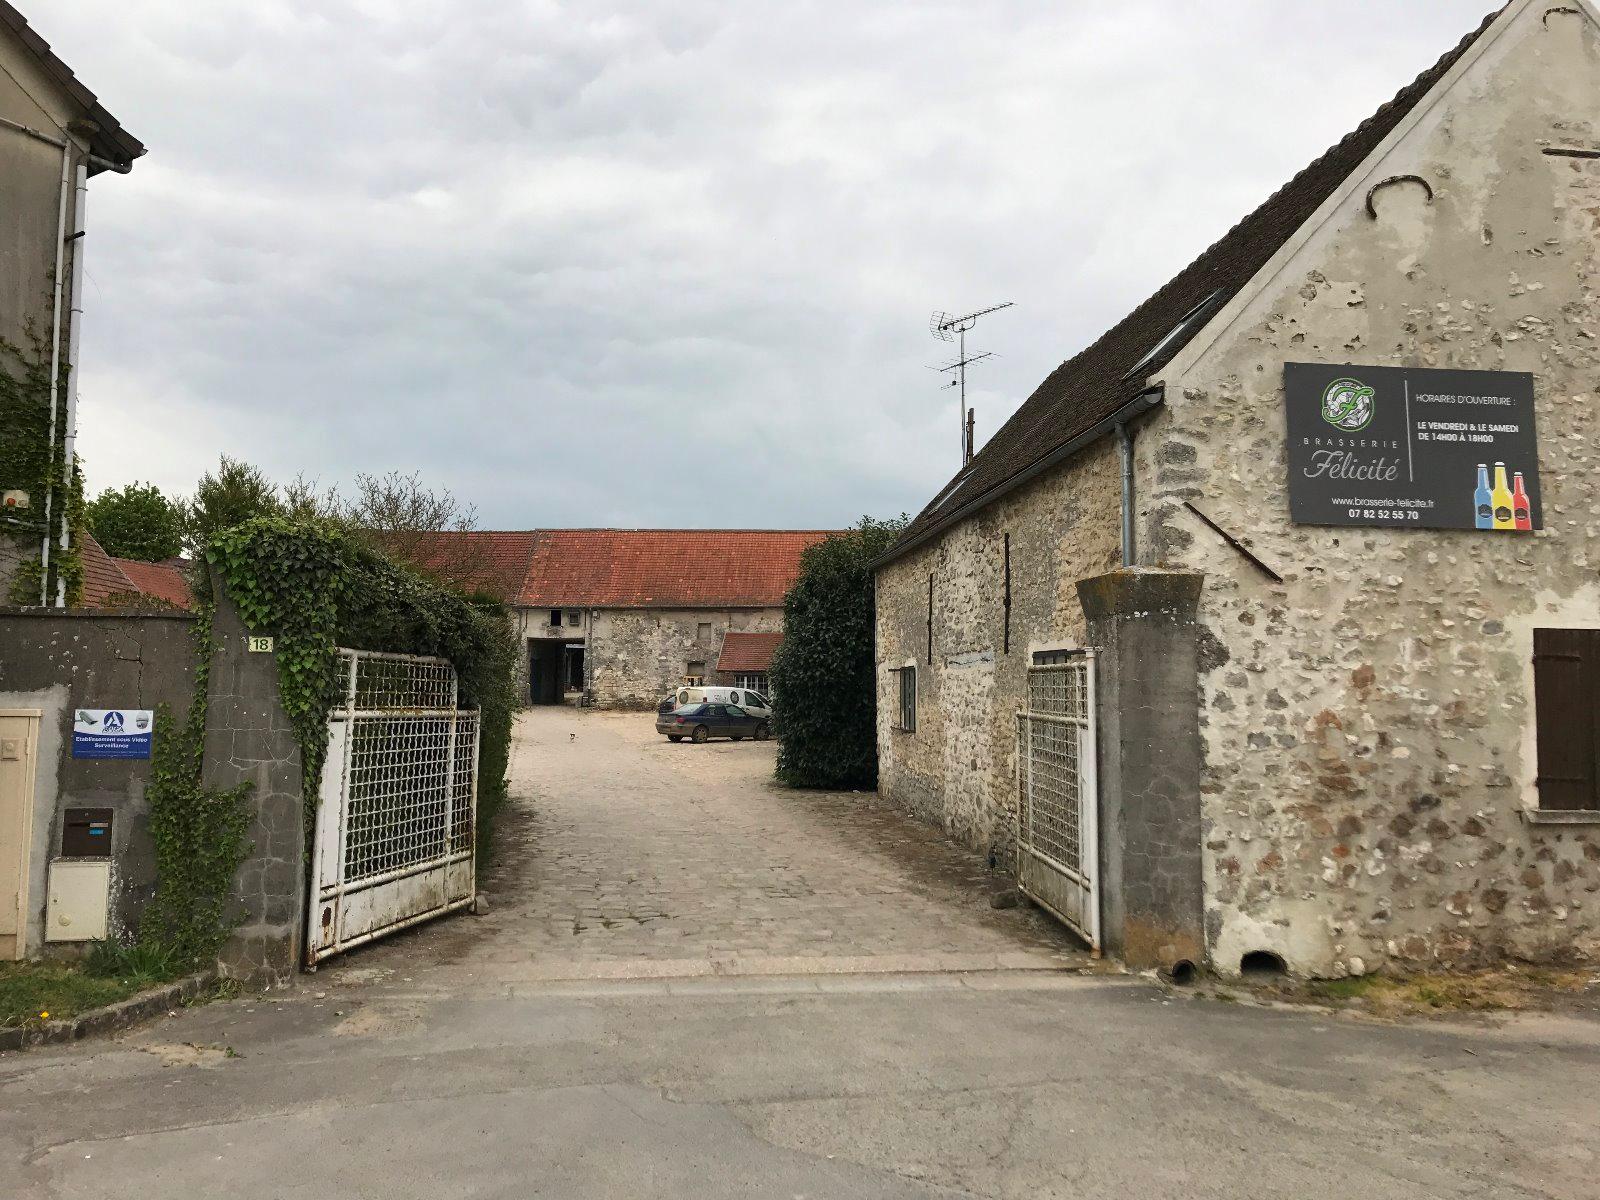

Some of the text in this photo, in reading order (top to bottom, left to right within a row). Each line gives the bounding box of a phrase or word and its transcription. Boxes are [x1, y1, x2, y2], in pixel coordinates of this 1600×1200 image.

[1416, 394, 1456, 404] HORAIRES
[1457, 395, 1511, 406] D'OUVERTURE
[1417, 421, 1520, 433] LE VENDREDI & LE SAMEDI
[1303, 437, 1398, 449] BRASSERIE
[1418, 432, 1429, 441] DE
[1431, 432, 1458, 442] 14H00
[1467, 434, 1494, 443] 18H00
[1303, 449, 1400, 481] Félicité
[1331, 497, 1435, 508] www.brasserie-felicite.fr
[1348, 509, 1419, 520] 07 82 52 55 70
[253, 639, 268, 650] 18
